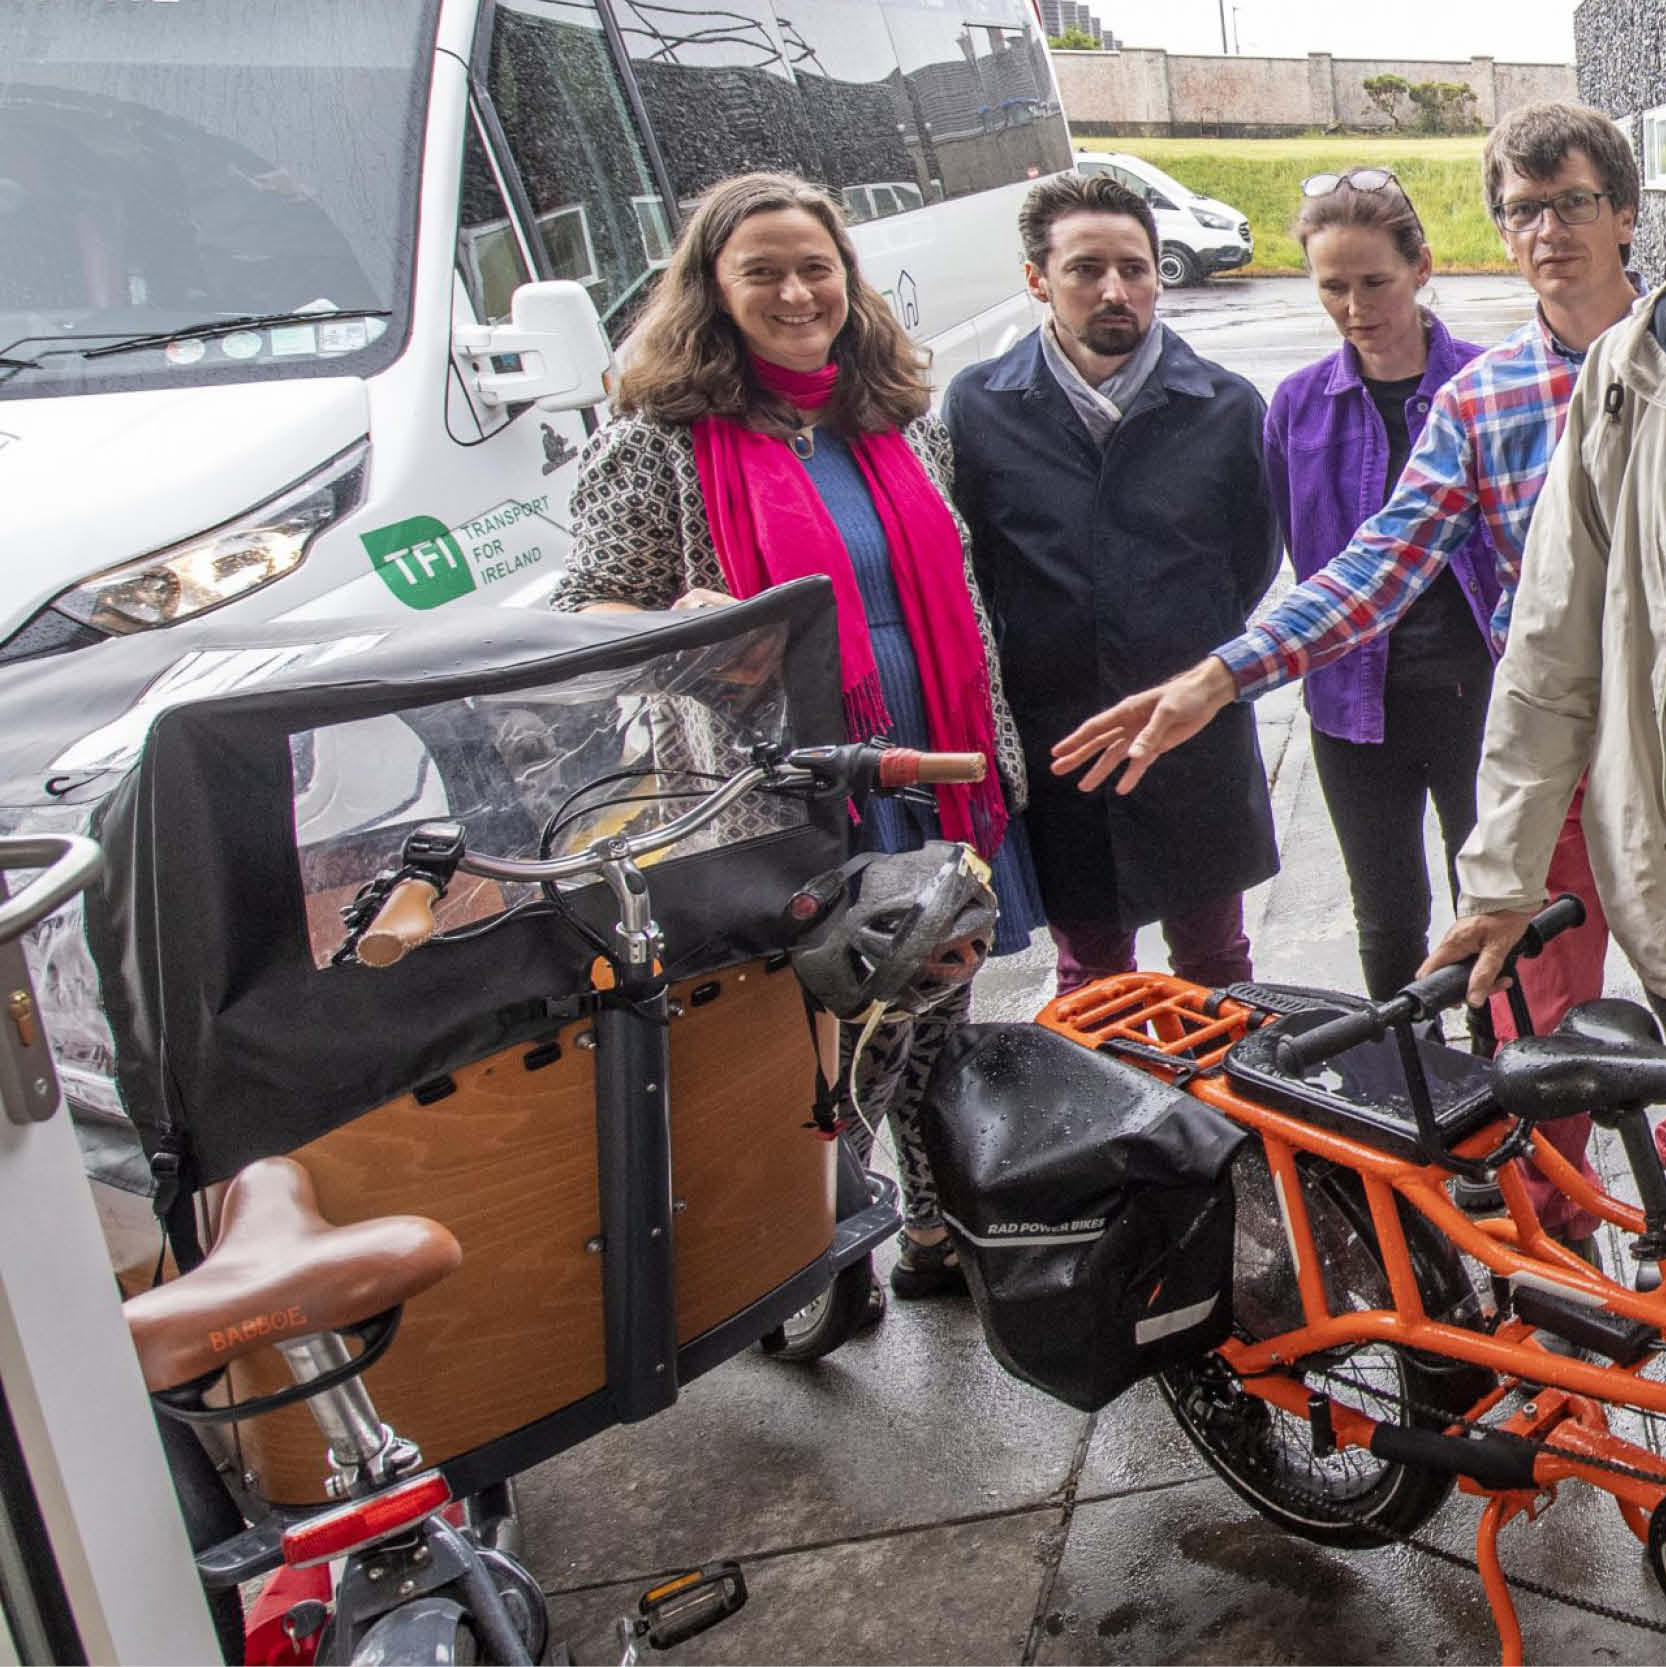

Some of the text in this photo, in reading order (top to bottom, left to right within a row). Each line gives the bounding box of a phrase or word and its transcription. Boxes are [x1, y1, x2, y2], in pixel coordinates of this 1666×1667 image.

[460, 496, 549, 540] TRANSPORT
[383, 535, 458, 585] TFI
[473, 539, 504, 562] FOR
[480, 546, 542, 584] IRELAND
[987, 1223, 1018, 1235] RAD
[1071, 1217, 1106, 1231] BIKES
